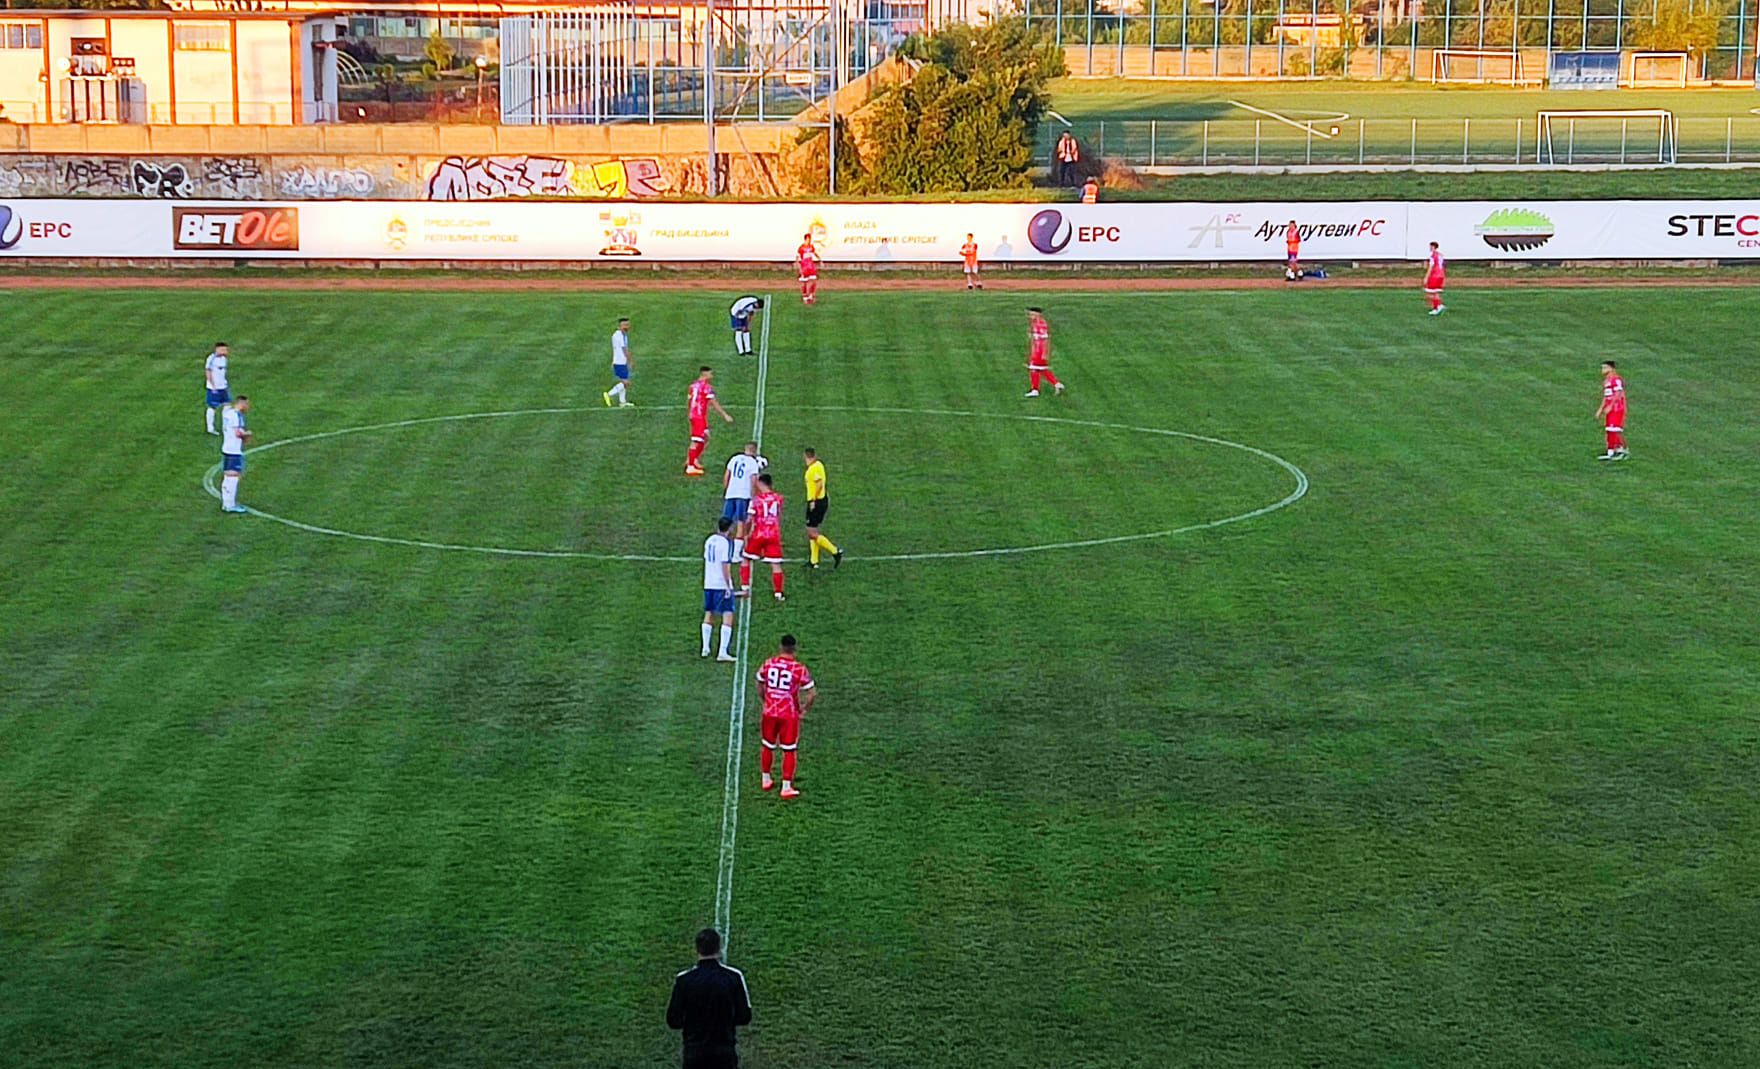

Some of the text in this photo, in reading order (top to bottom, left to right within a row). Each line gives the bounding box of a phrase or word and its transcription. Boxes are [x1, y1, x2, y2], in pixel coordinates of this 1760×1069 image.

[1254, 220, 1357, 241] Аутпутеви
[733, 460, 746, 479] 16
[763, 501, 779, 518] 14
[708, 543, 716, 564] 11
[767, 667, 793, 690] 92
